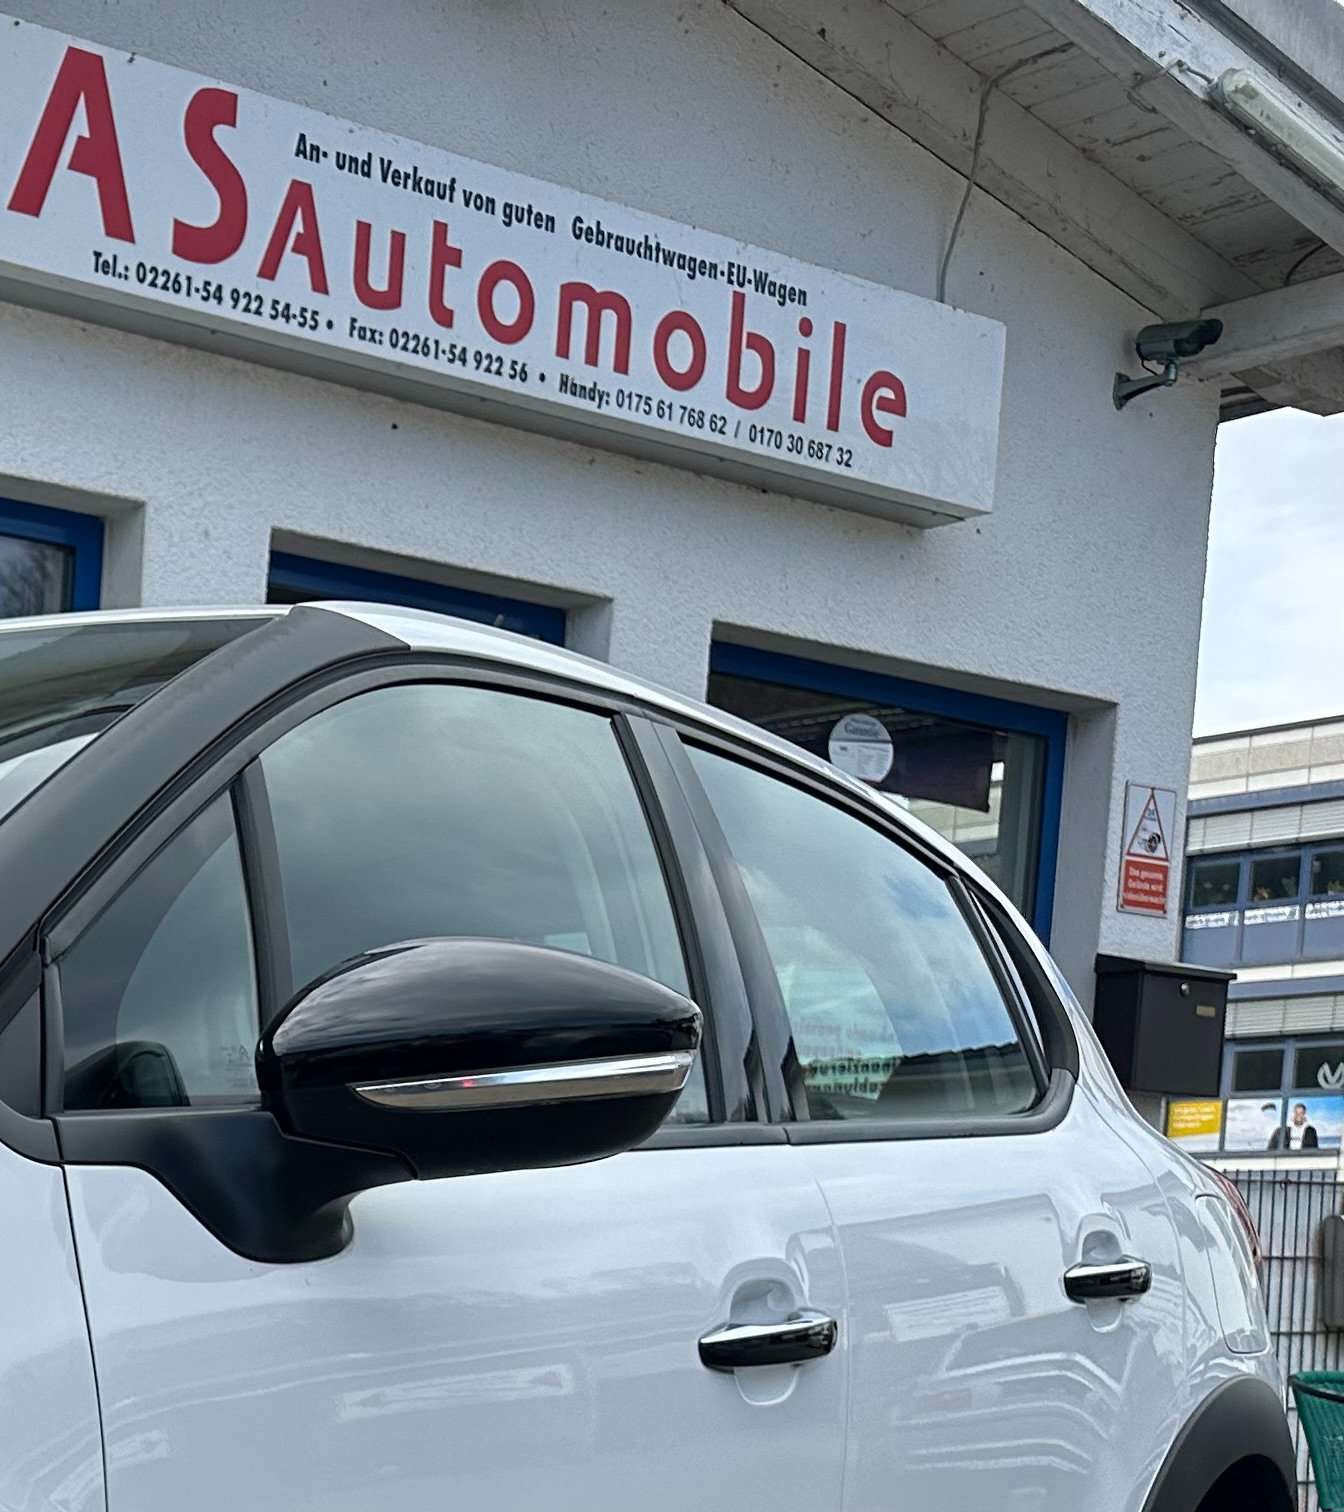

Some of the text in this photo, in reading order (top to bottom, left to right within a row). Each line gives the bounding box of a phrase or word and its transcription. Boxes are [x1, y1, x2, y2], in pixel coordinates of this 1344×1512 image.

[257, 178, 907, 448] Automobile
[294, 133, 808, 307] An- und Verkauf von guten Gebrauchtwagen-EU-Wagen
[93, 250, 129, 281] Tel.:
[135, 262, 223, 305] 02261-54
[230, 288, 264, 316] 922
[269, 299, 320, 331] 54-55
[348, 317, 384, 345] Fax:
[389, 328, 468, 366] 02261-54
[473, 351, 504, 376] 922
[508, 360, 529, 382] 56
[558, 372, 610, 408] Handy:
[615, 388, 653, 415] 0175
[656, 399, 673, 421] 61
[679, 405, 705, 429] 768
[709, 413, 727, 436] 62
[748, 424, 783, 450] 0170
[787, 434, 804, 455] 30
[808, 439, 833, 462] 687
[836, 447, 853, 468] 32
